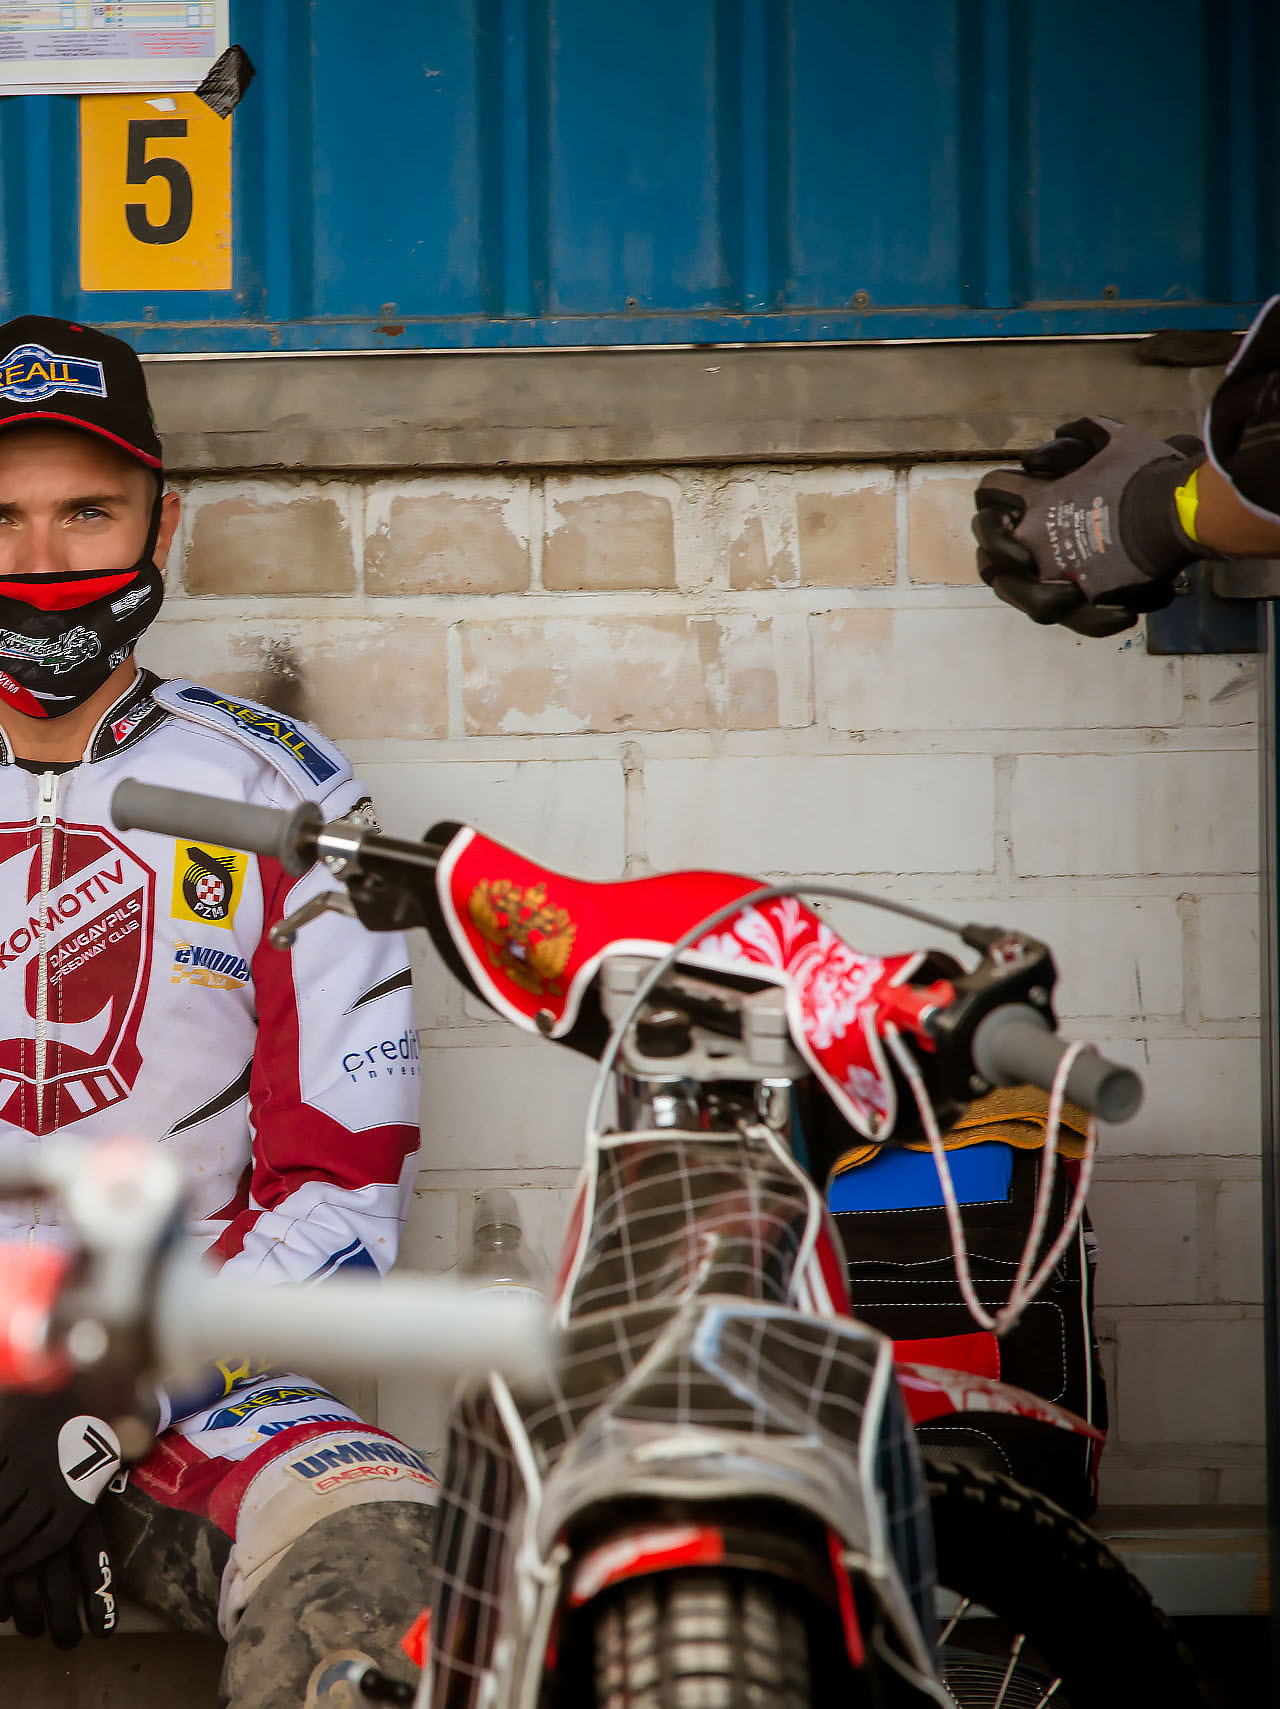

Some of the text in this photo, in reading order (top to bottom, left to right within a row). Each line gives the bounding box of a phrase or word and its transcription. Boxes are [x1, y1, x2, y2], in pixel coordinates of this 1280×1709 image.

[124, 119, 193, 245] 5
[214, 699, 305, 761] REALL
[49, 899, 141, 969] DAUGAVPILS
[193, 902, 225, 919] PZM
[50, 920, 140, 986] SPEEDWAY CLUB
